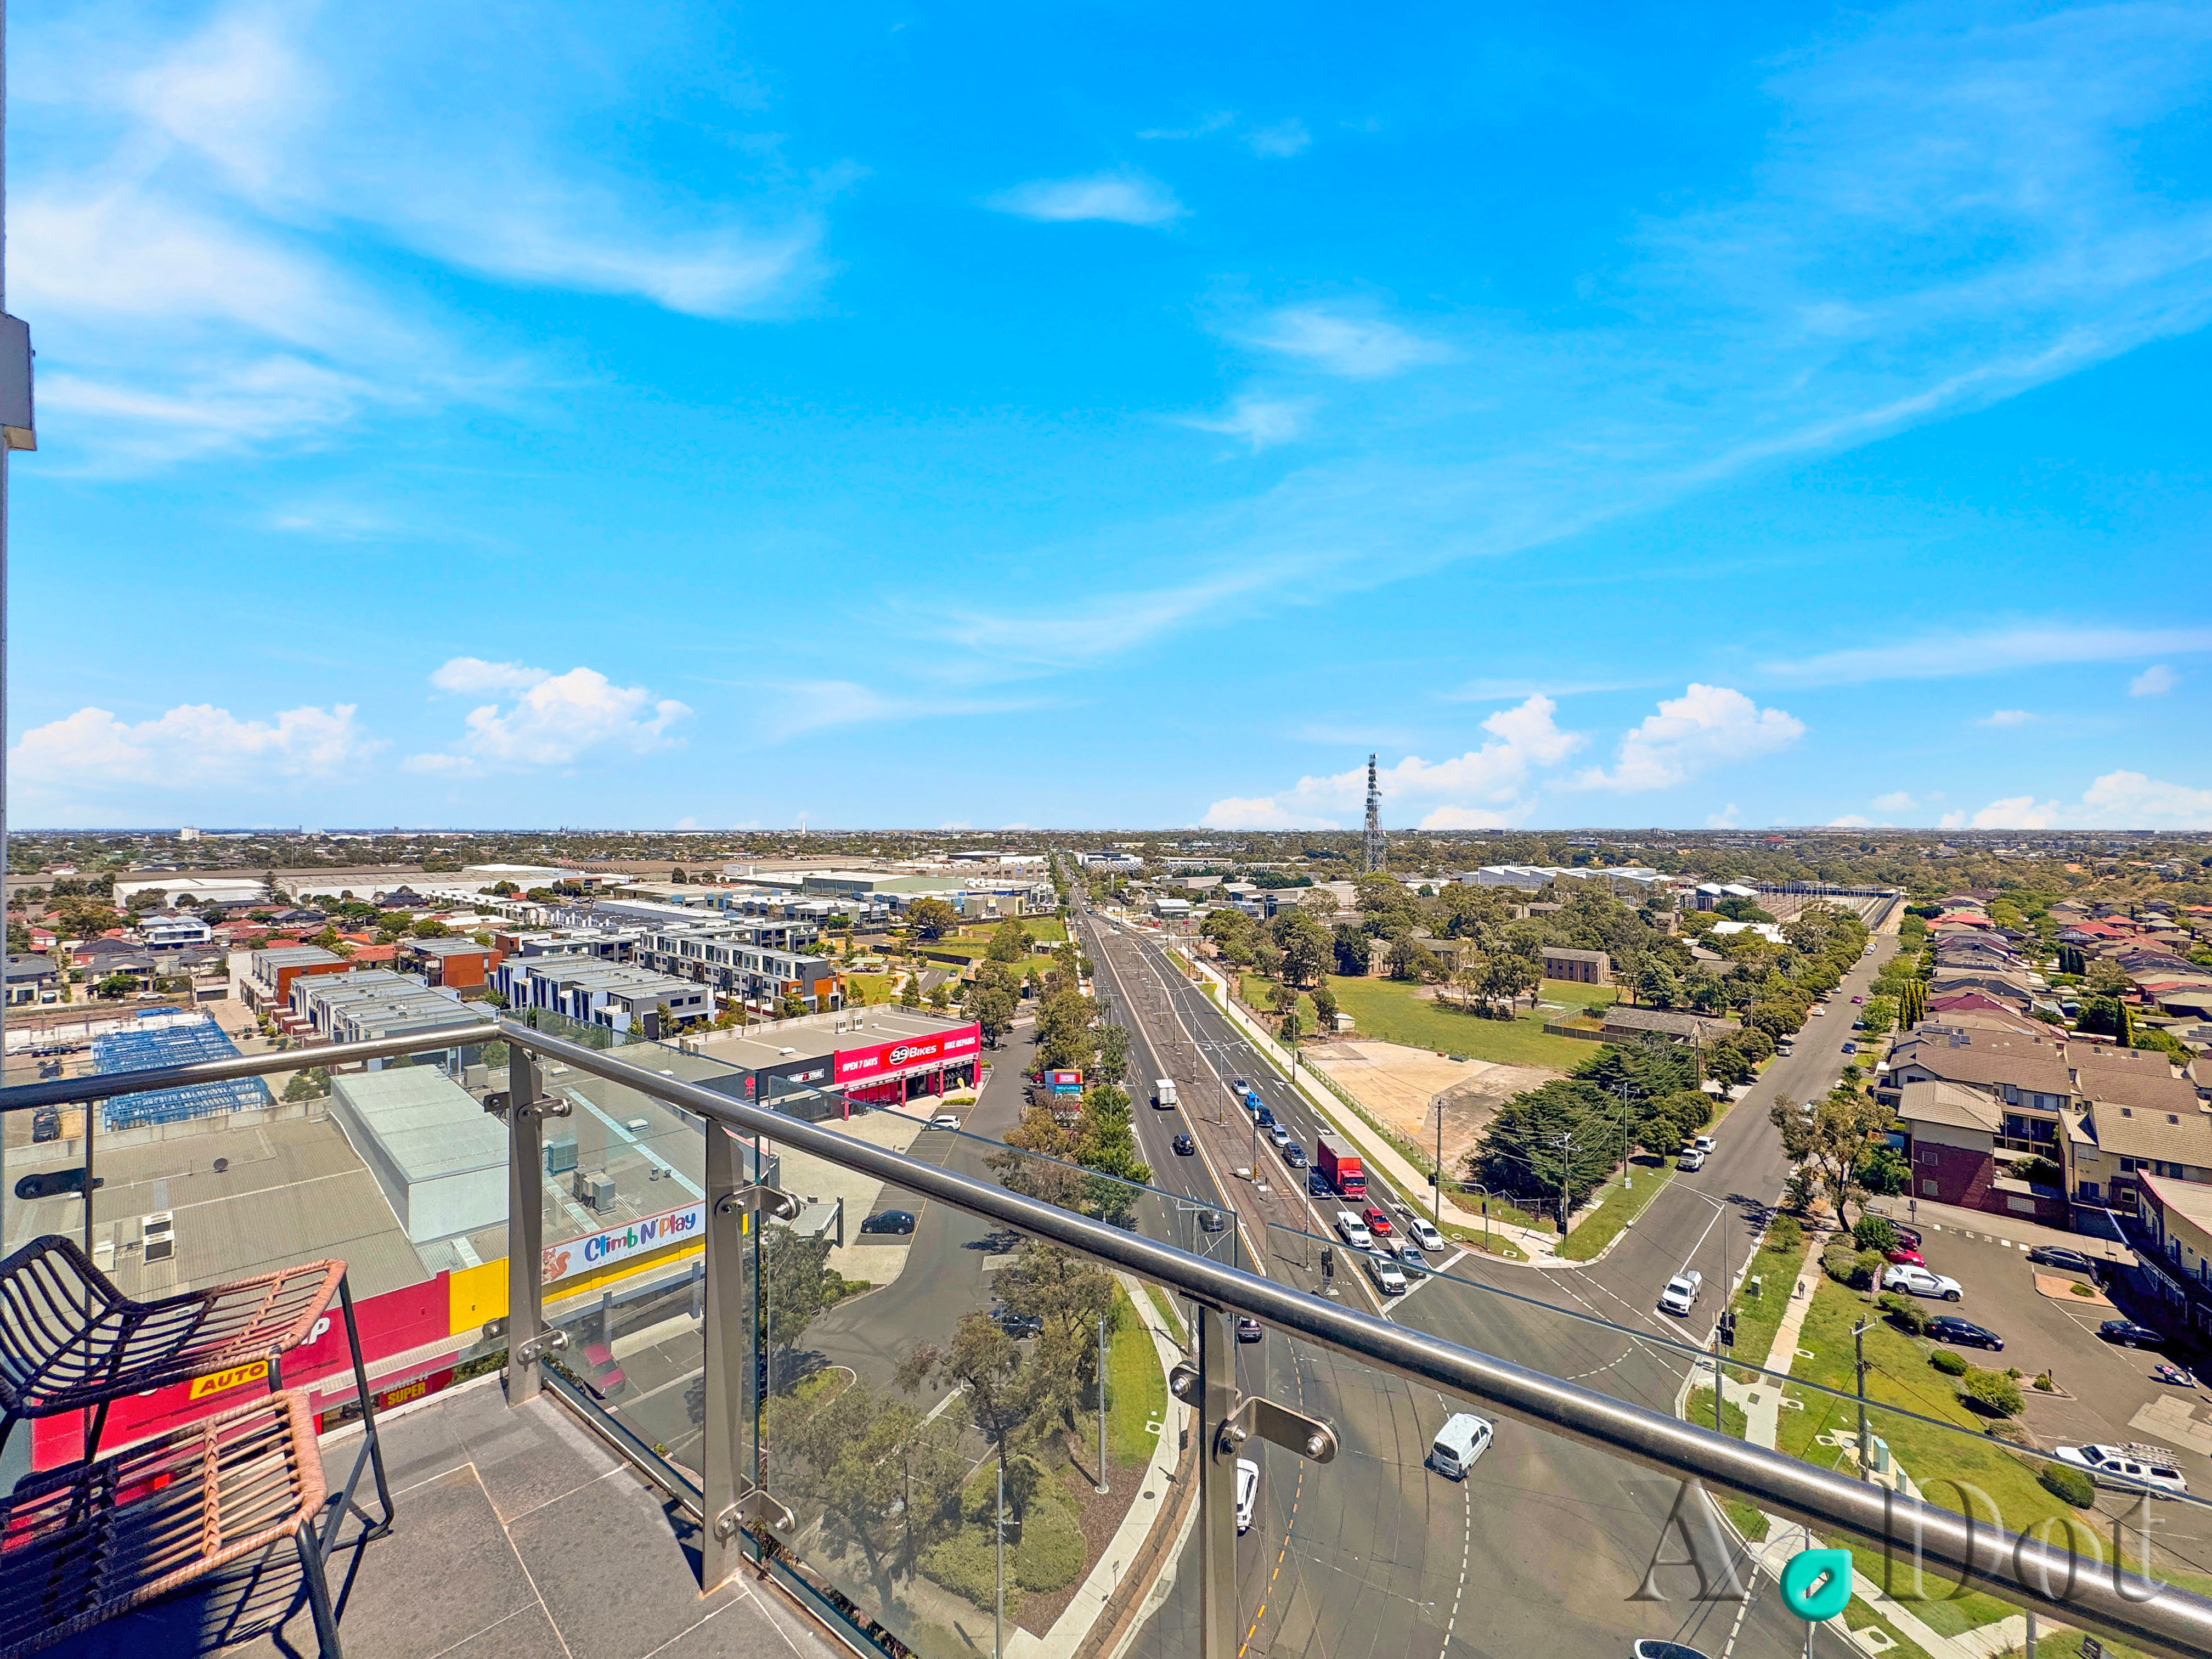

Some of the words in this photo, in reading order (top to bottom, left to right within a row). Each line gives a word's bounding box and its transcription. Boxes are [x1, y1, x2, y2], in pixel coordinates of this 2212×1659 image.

[944, 1041, 956, 1050] BIKE
[956, 1037, 975, 1047] REPAIRS
[890, 1048, 908, 1061] 99
[843, 1062, 858, 1072] OPEN
[859, 1060, 863, 1069] 7
[863, 1057, 878, 1068] DAYS
[808, 1070, 823, 1079] STORE
[585, 1227, 638, 1262] Climb
[659, 1212, 696, 1238] Play
[199, 1363, 264, 1393] AUTO
[387, 1381, 426, 1406] SUPER
